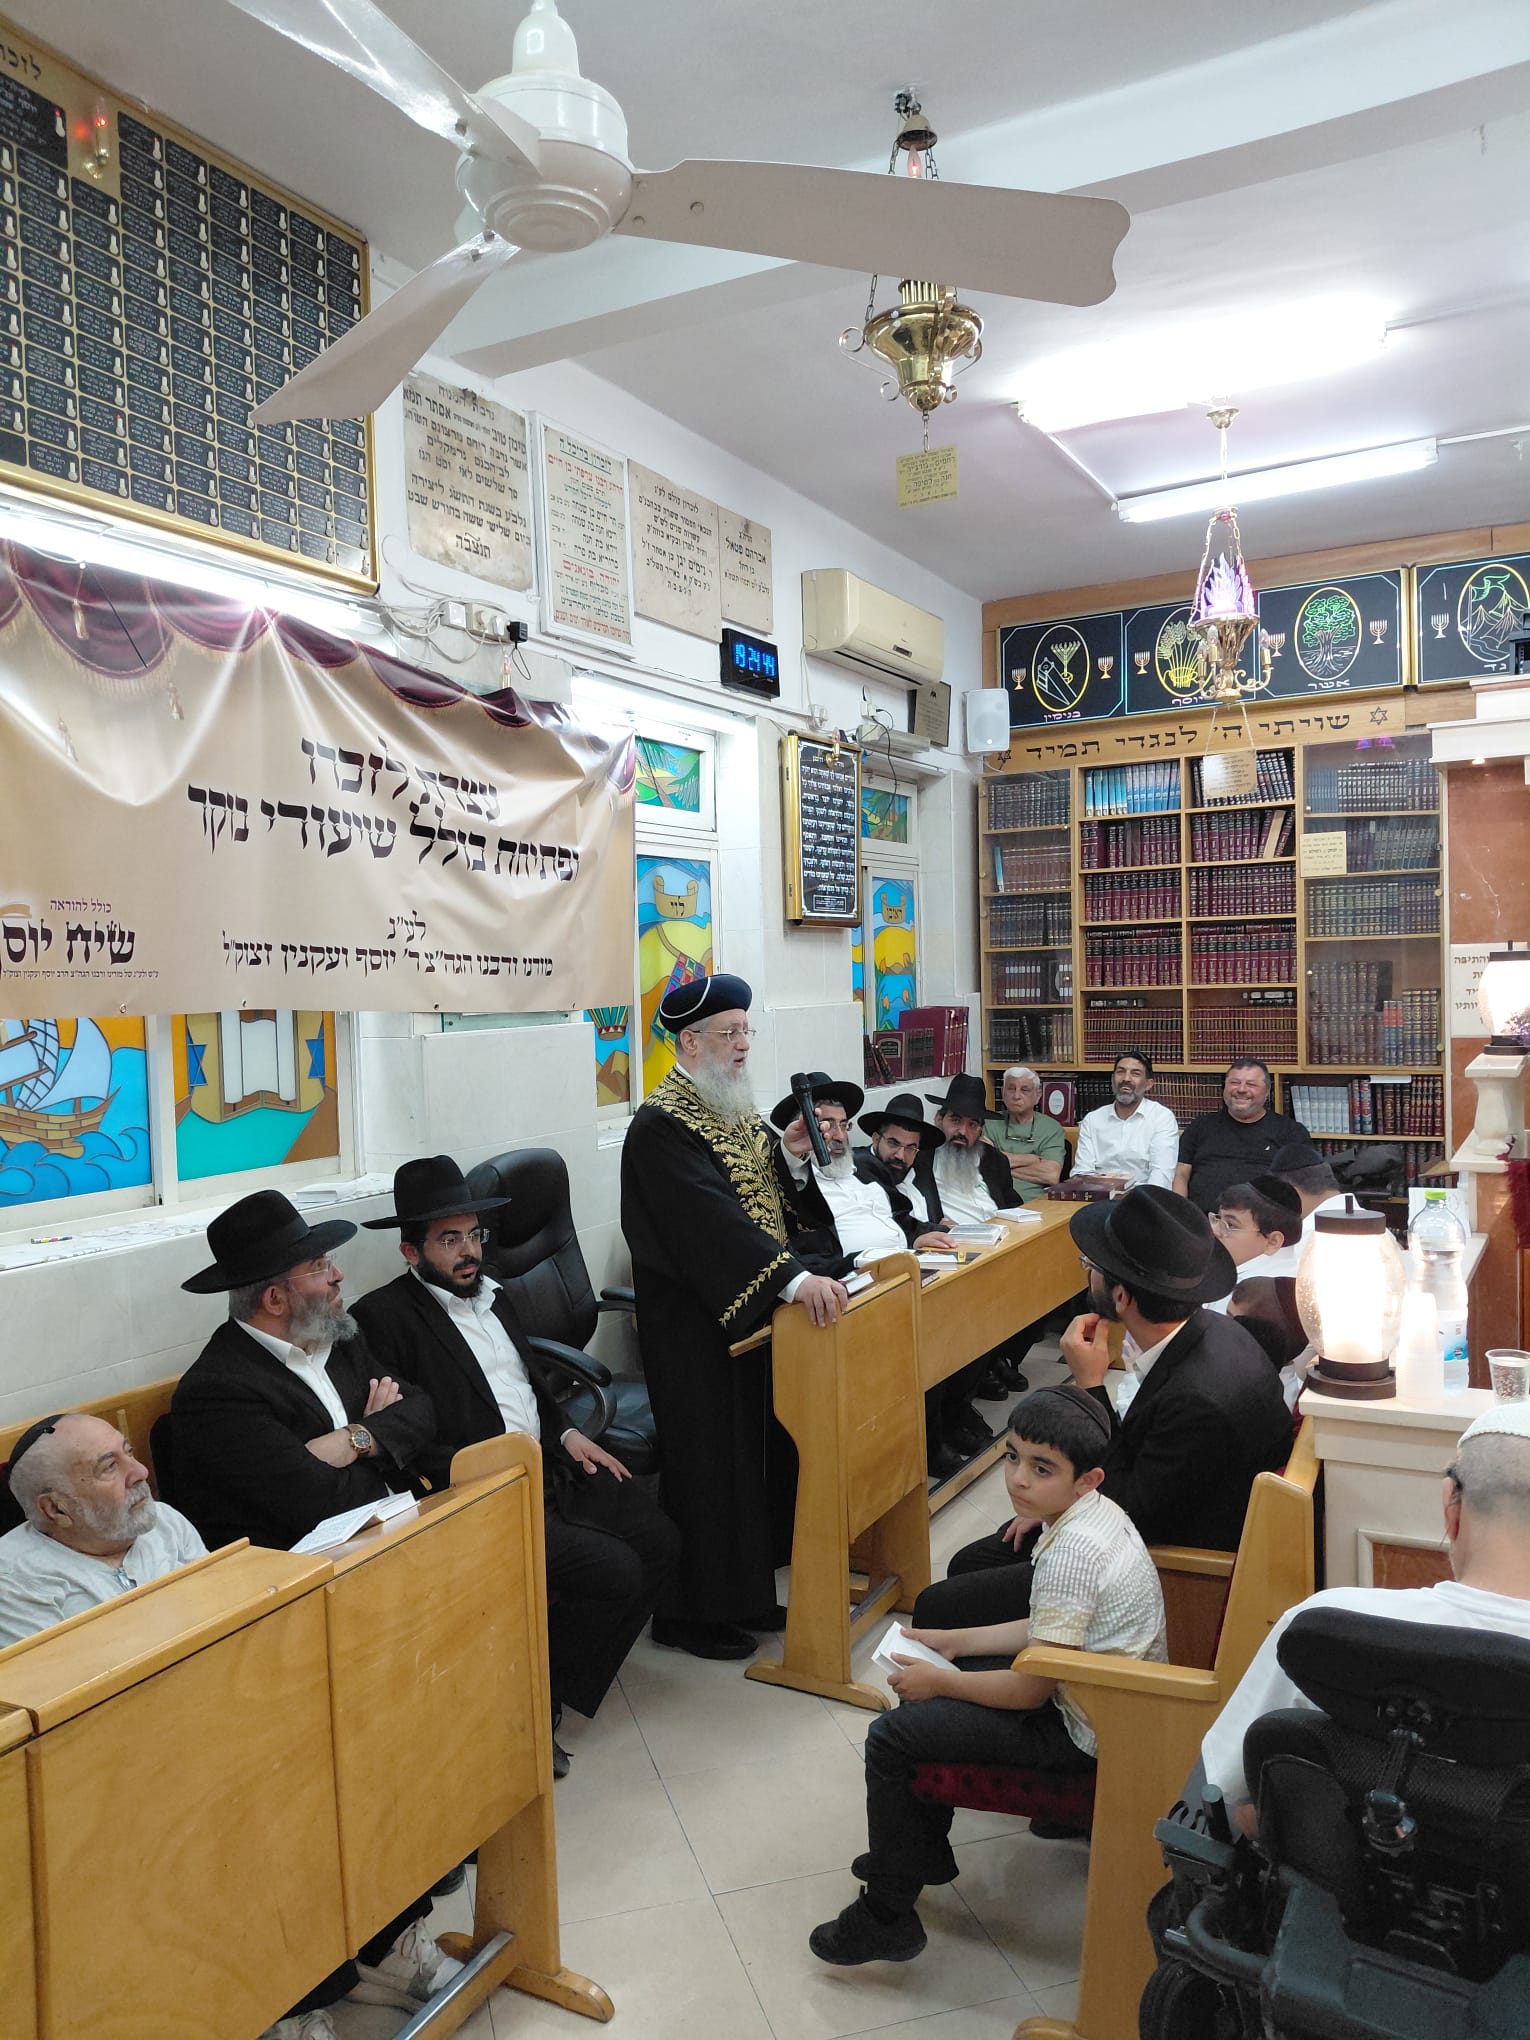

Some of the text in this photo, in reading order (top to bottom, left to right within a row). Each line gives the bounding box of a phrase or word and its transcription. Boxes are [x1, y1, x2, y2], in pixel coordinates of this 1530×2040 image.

[408, 490, 427, 507] שבט
[1308, 679, 1350, 690] אשר
[1115, 725, 1198, 749] לנגדי
[1258, 714, 1351, 737] שויתי
[1026, 739, 1100, 760] תמיד
[302, 736, 498, 822] עצרת לזכרו
[261, 799, 397, 858] שיעורי
[409, 801, 487, 872] כולל
[496, 836, 580, 881] ופתיחת
[50, 898, 112, 913] כולל להוראה
[0, 918, 136, 979] שיח יוס
[281, 944, 349, 977] ועקנין
[356, 947, 397, 977] יוסף
[477, 954, 519, 976] ורבנו
[523, 957, 553, 977] מורנו
